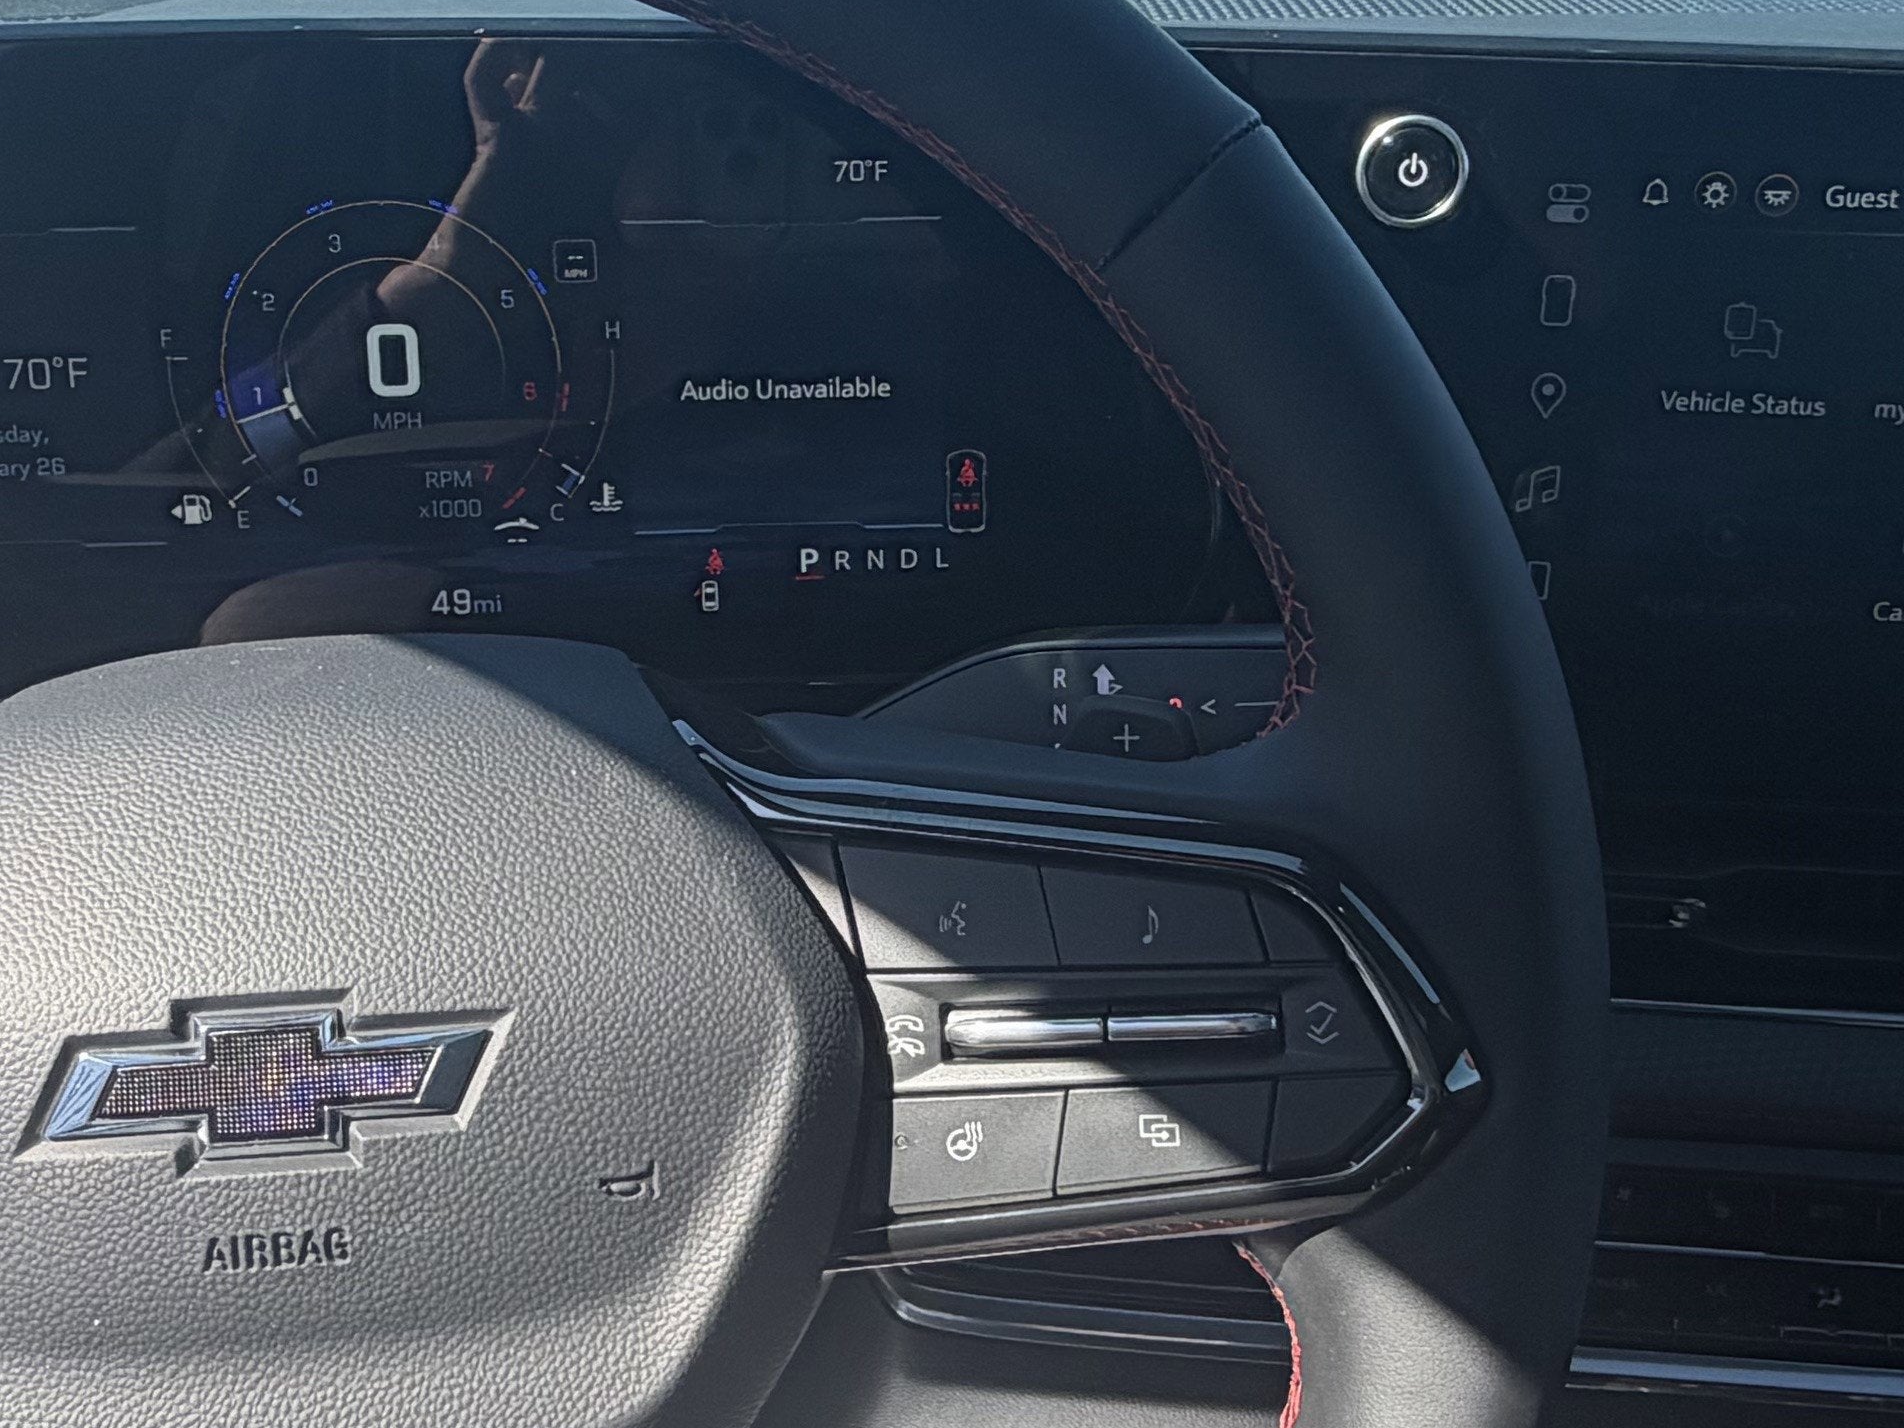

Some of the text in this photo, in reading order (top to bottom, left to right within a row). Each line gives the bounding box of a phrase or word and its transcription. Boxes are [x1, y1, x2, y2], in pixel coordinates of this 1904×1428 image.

[834, 160, 888, 183] 70°F
[1825, 185, 1900, 211] Guest
[328, 234, 341, 253] 3
[262, 293, 275, 312] 2
[500, 289, 515, 309] 5
[160, 329, 172, 347] F
[605, 321, 620, 339] H
[366, 323, 420, 397] 0
[3, 357, 88, 390] 70°F
[253, 386, 262, 405] 1
[680, 376, 891, 403] Audio Unavailable
[1661, 390, 1826, 418] Vehicle Status
[373, 412, 423, 430] MPH
[37, 456, 66, 477] 26
[303, 467, 318, 486] 0
[482, 464, 495, 482] 7
[425, 471, 473, 489] RPM
[419, 499, 482, 519] x1000
[550, 503, 565, 521] C
[238, 511, 250, 529] E
[800, 548, 949, 573] P R N D L
[1053, 668, 1067, 689] R
[1053, 703, 1067, 725] N
[202, 1228, 352, 1273] AIRBAG
